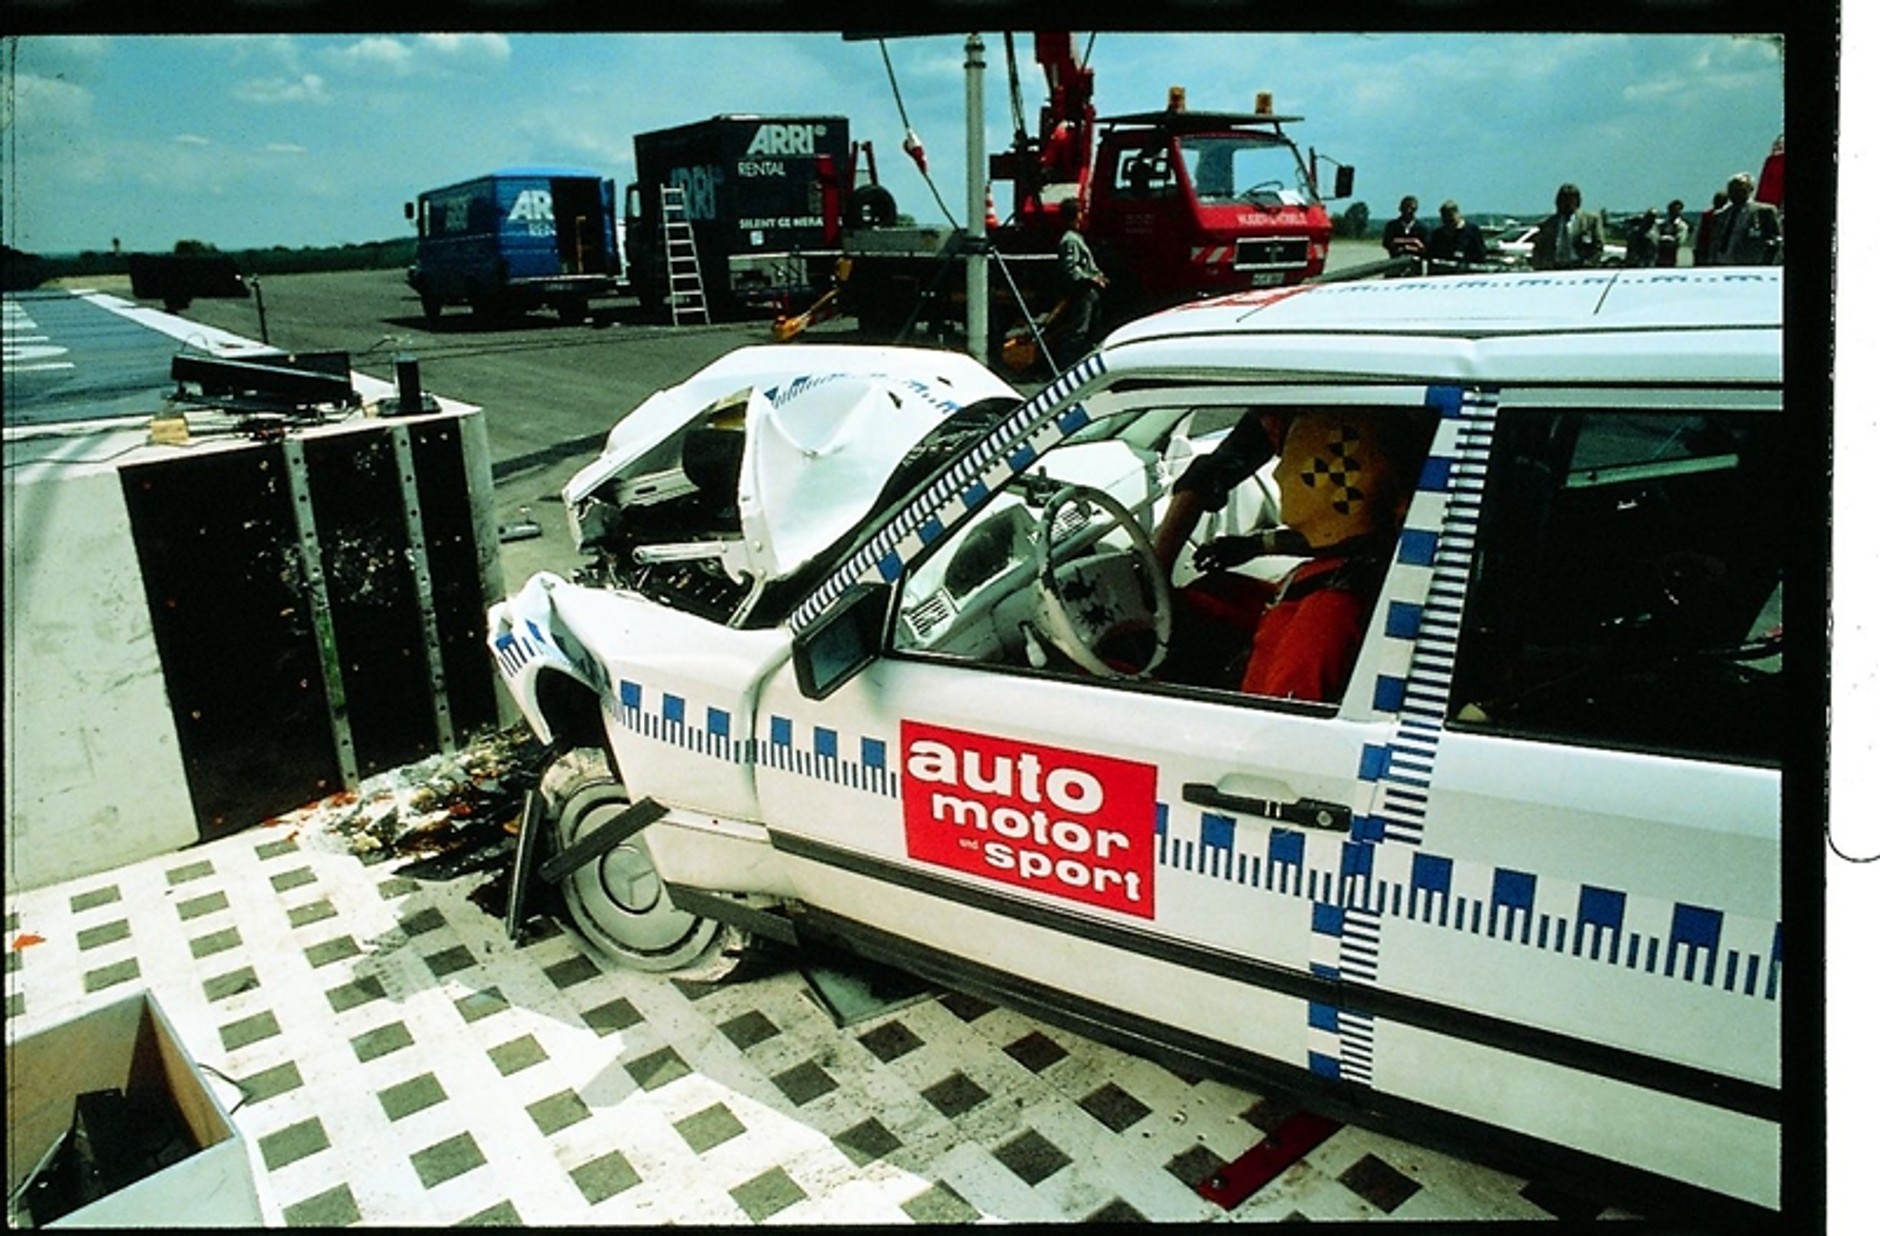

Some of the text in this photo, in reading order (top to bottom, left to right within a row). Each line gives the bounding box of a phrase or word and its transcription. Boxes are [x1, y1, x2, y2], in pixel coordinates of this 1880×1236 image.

[738, 162, 786, 177] RENTAL
[907, 738, 1104, 815] auto
[931, 790, 1130, 858] motor
[983, 840, 1141, 902] sport
